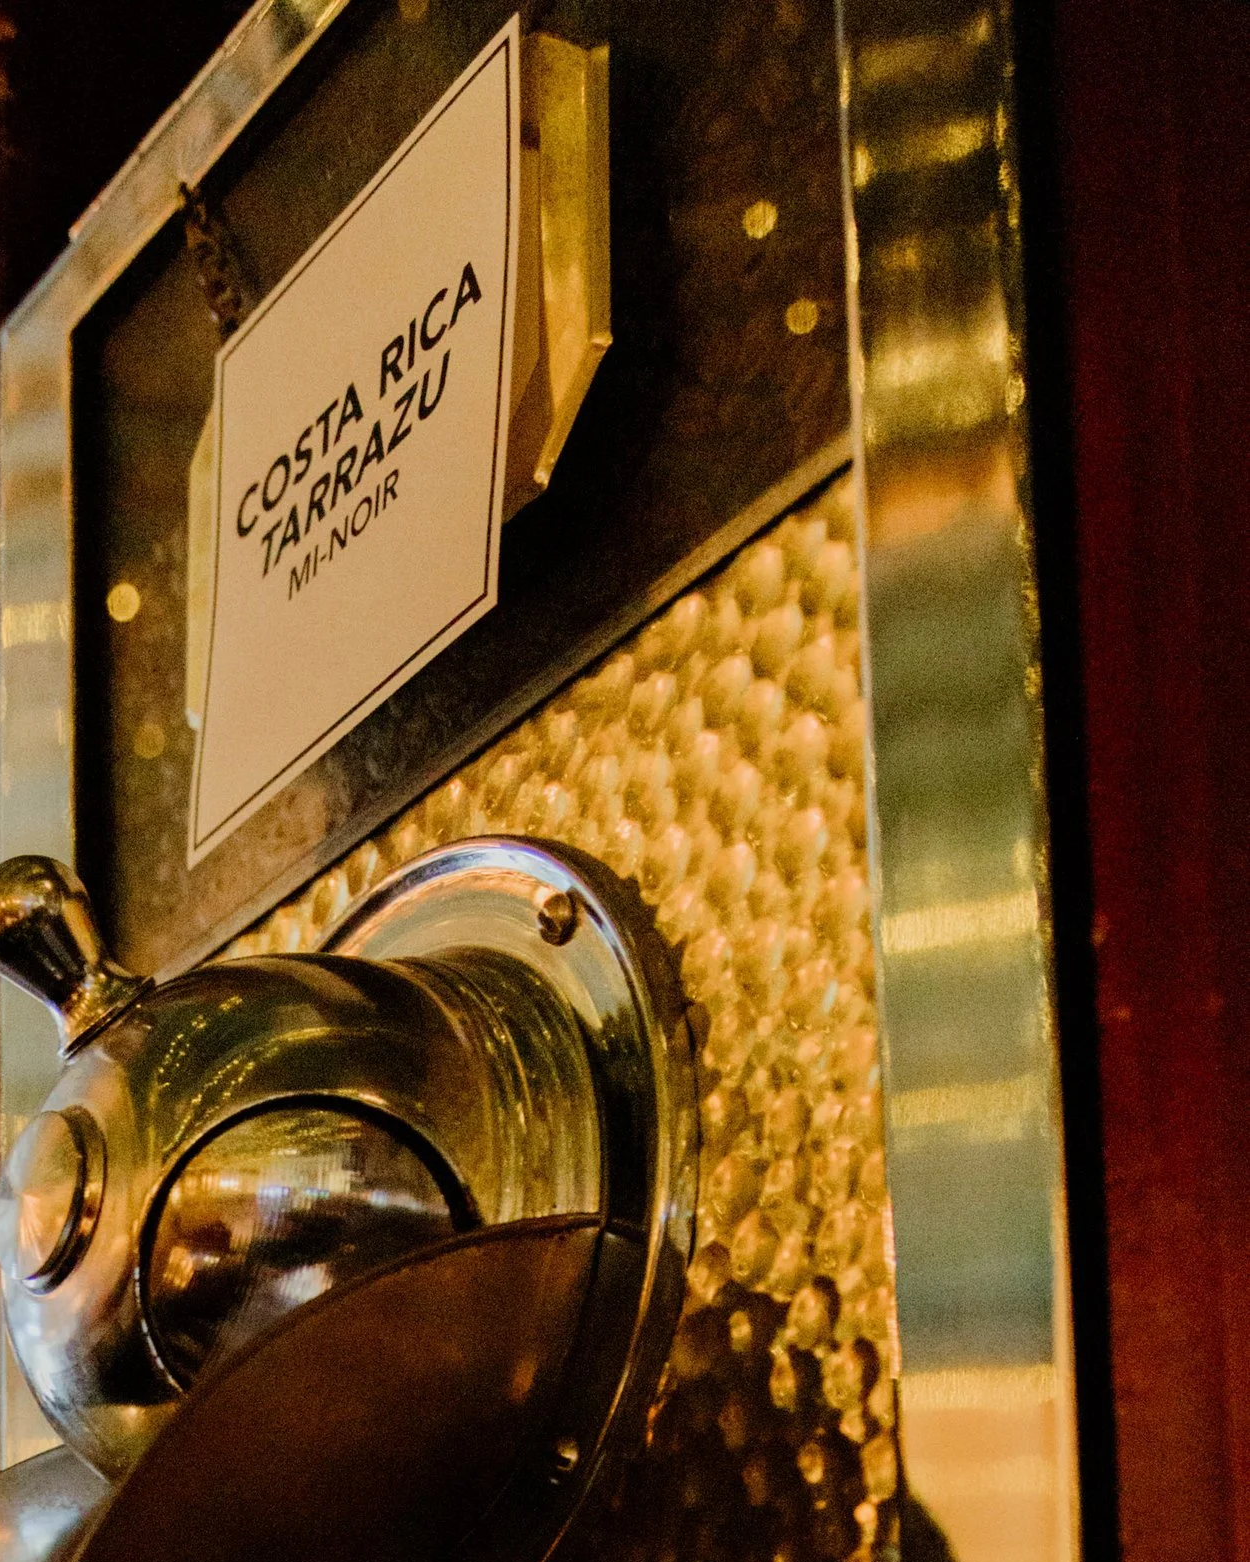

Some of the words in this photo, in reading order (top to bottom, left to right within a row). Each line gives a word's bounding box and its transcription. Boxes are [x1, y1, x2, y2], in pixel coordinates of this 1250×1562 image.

[236, 382, 364, 538] COSTA
[379, 261, 483, 398] RICA
[260, 348, 451, 579] TARRAZU
[288, 469, 400, 600] MI-NOIR
